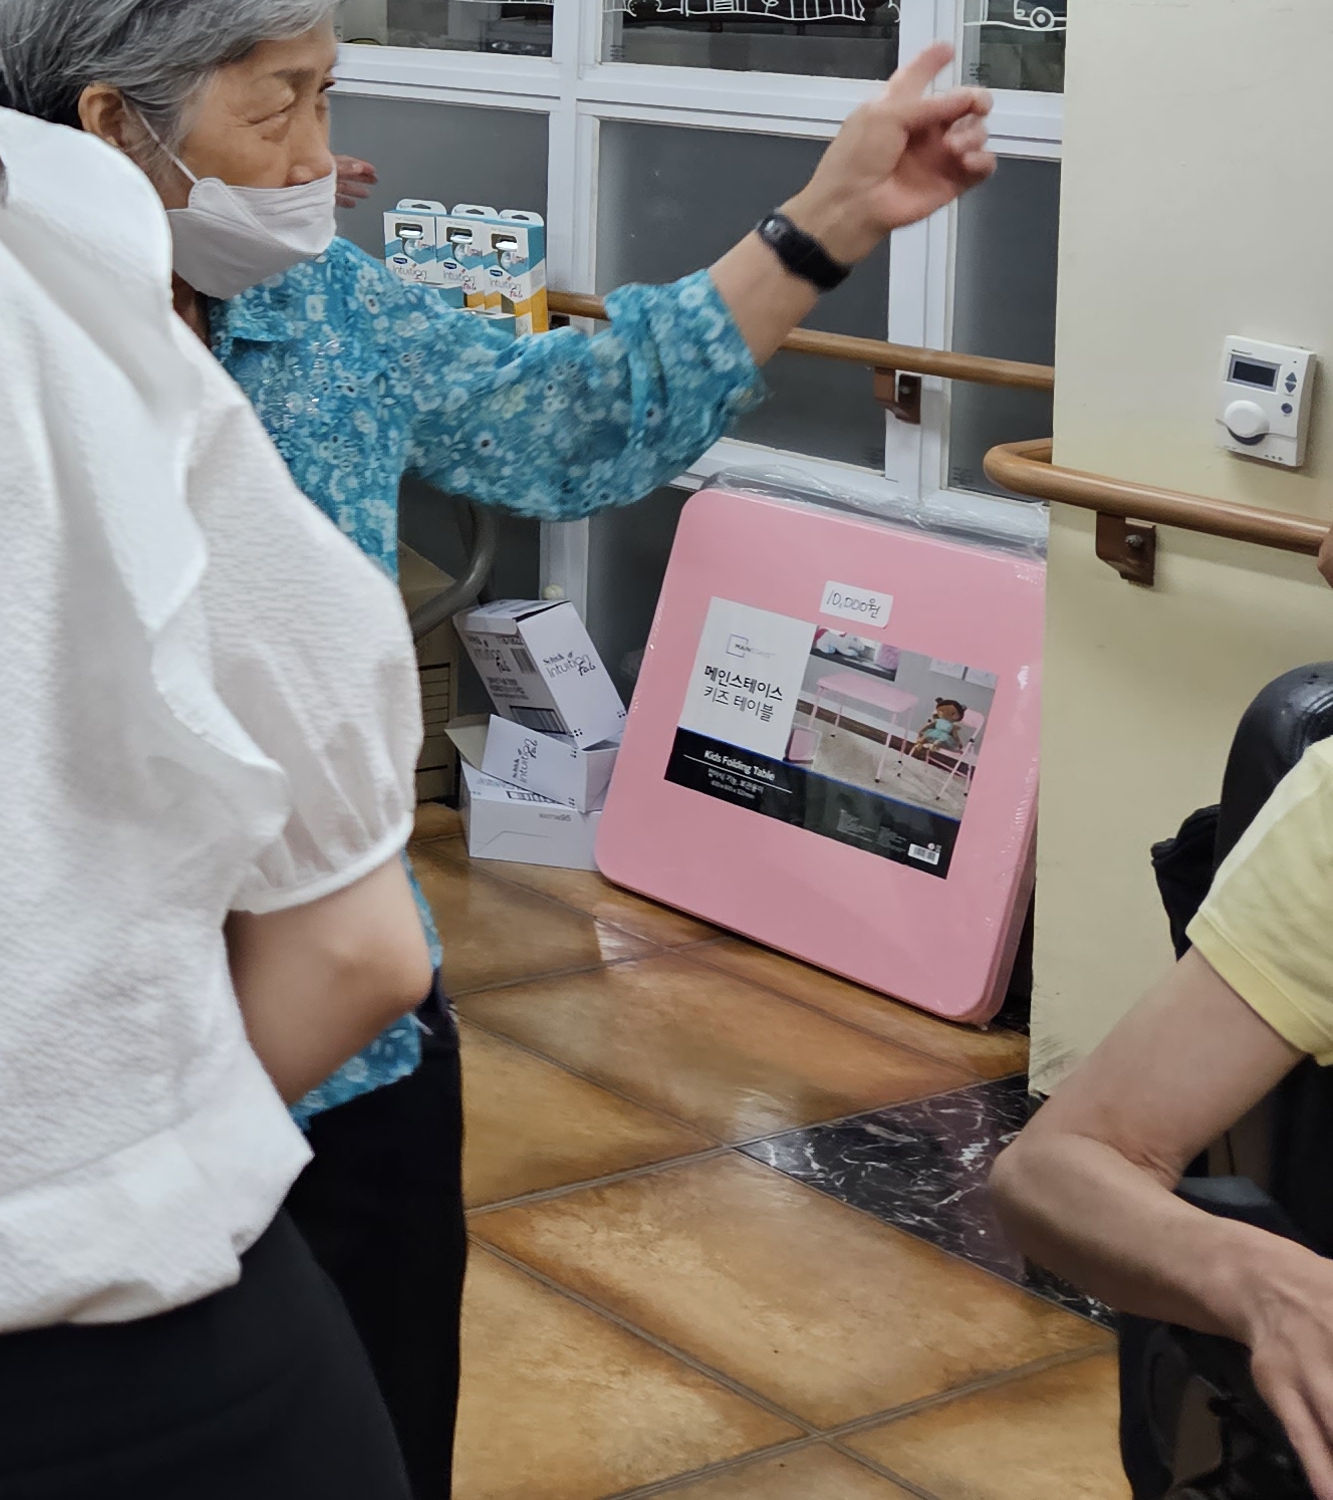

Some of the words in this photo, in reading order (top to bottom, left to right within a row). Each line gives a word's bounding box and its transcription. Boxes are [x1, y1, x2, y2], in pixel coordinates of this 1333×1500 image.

[826, 589, 882, 619] 10,000원
[546, 653, 592, 679] Intuition
[704, 665, 783, 701] 메인스테이스
[703, 685, 730, 706] 키즈
[733, 695, 774, 722] 테이블
[704, 750, 723, 764] Kids
[722, 755, 751, 775] Folding
[752, 765, 776, 781] Table
